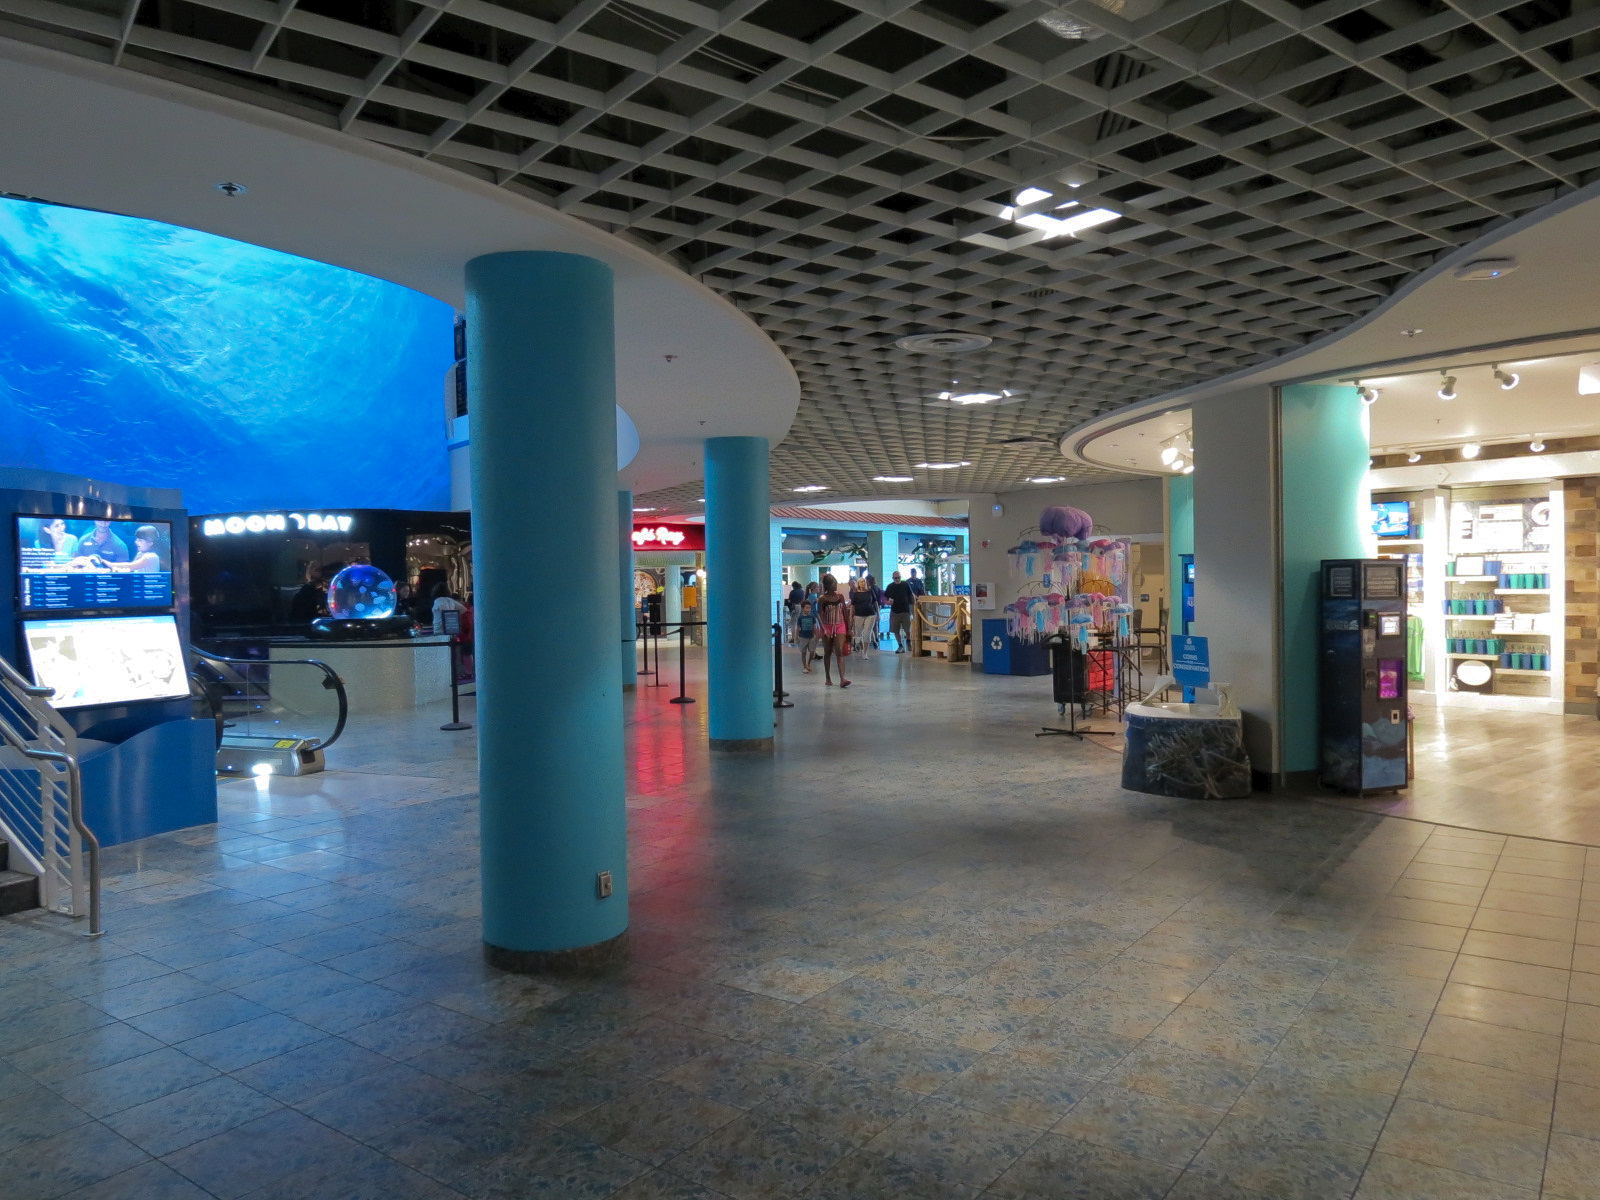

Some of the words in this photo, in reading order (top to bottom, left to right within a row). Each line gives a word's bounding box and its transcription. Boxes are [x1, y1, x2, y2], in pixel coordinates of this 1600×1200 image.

[203, 515, 286, 536] MOON
[307, 513, 352, 532] BAY
[1173, 662, 1209, 672] CONSERVATION
